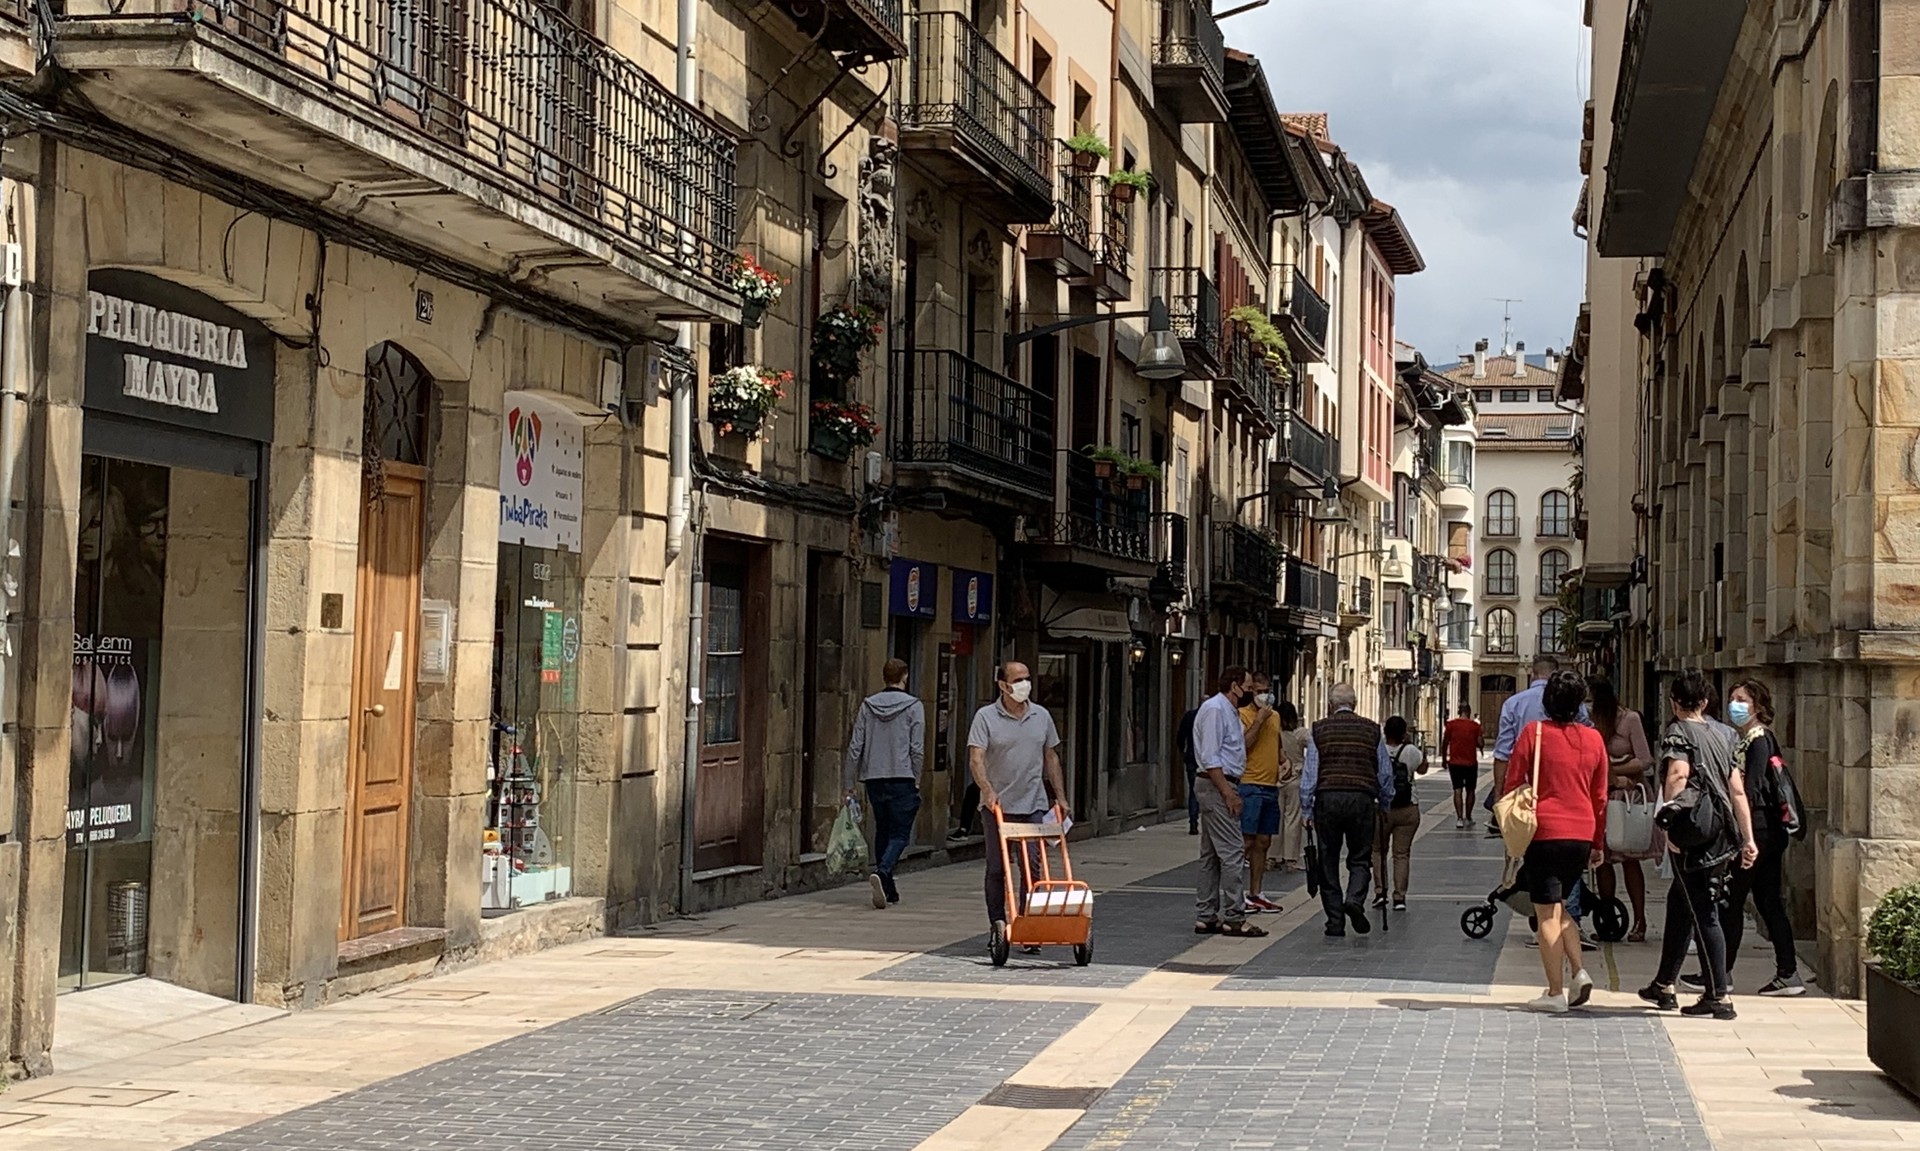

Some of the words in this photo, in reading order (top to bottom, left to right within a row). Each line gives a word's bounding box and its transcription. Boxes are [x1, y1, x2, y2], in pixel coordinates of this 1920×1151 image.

[87, 290, 248, 369] PELUQUERIA
[123, 353, 219, 413] MAYRA
[89, 803, 132, 826] PELUQUERIA
